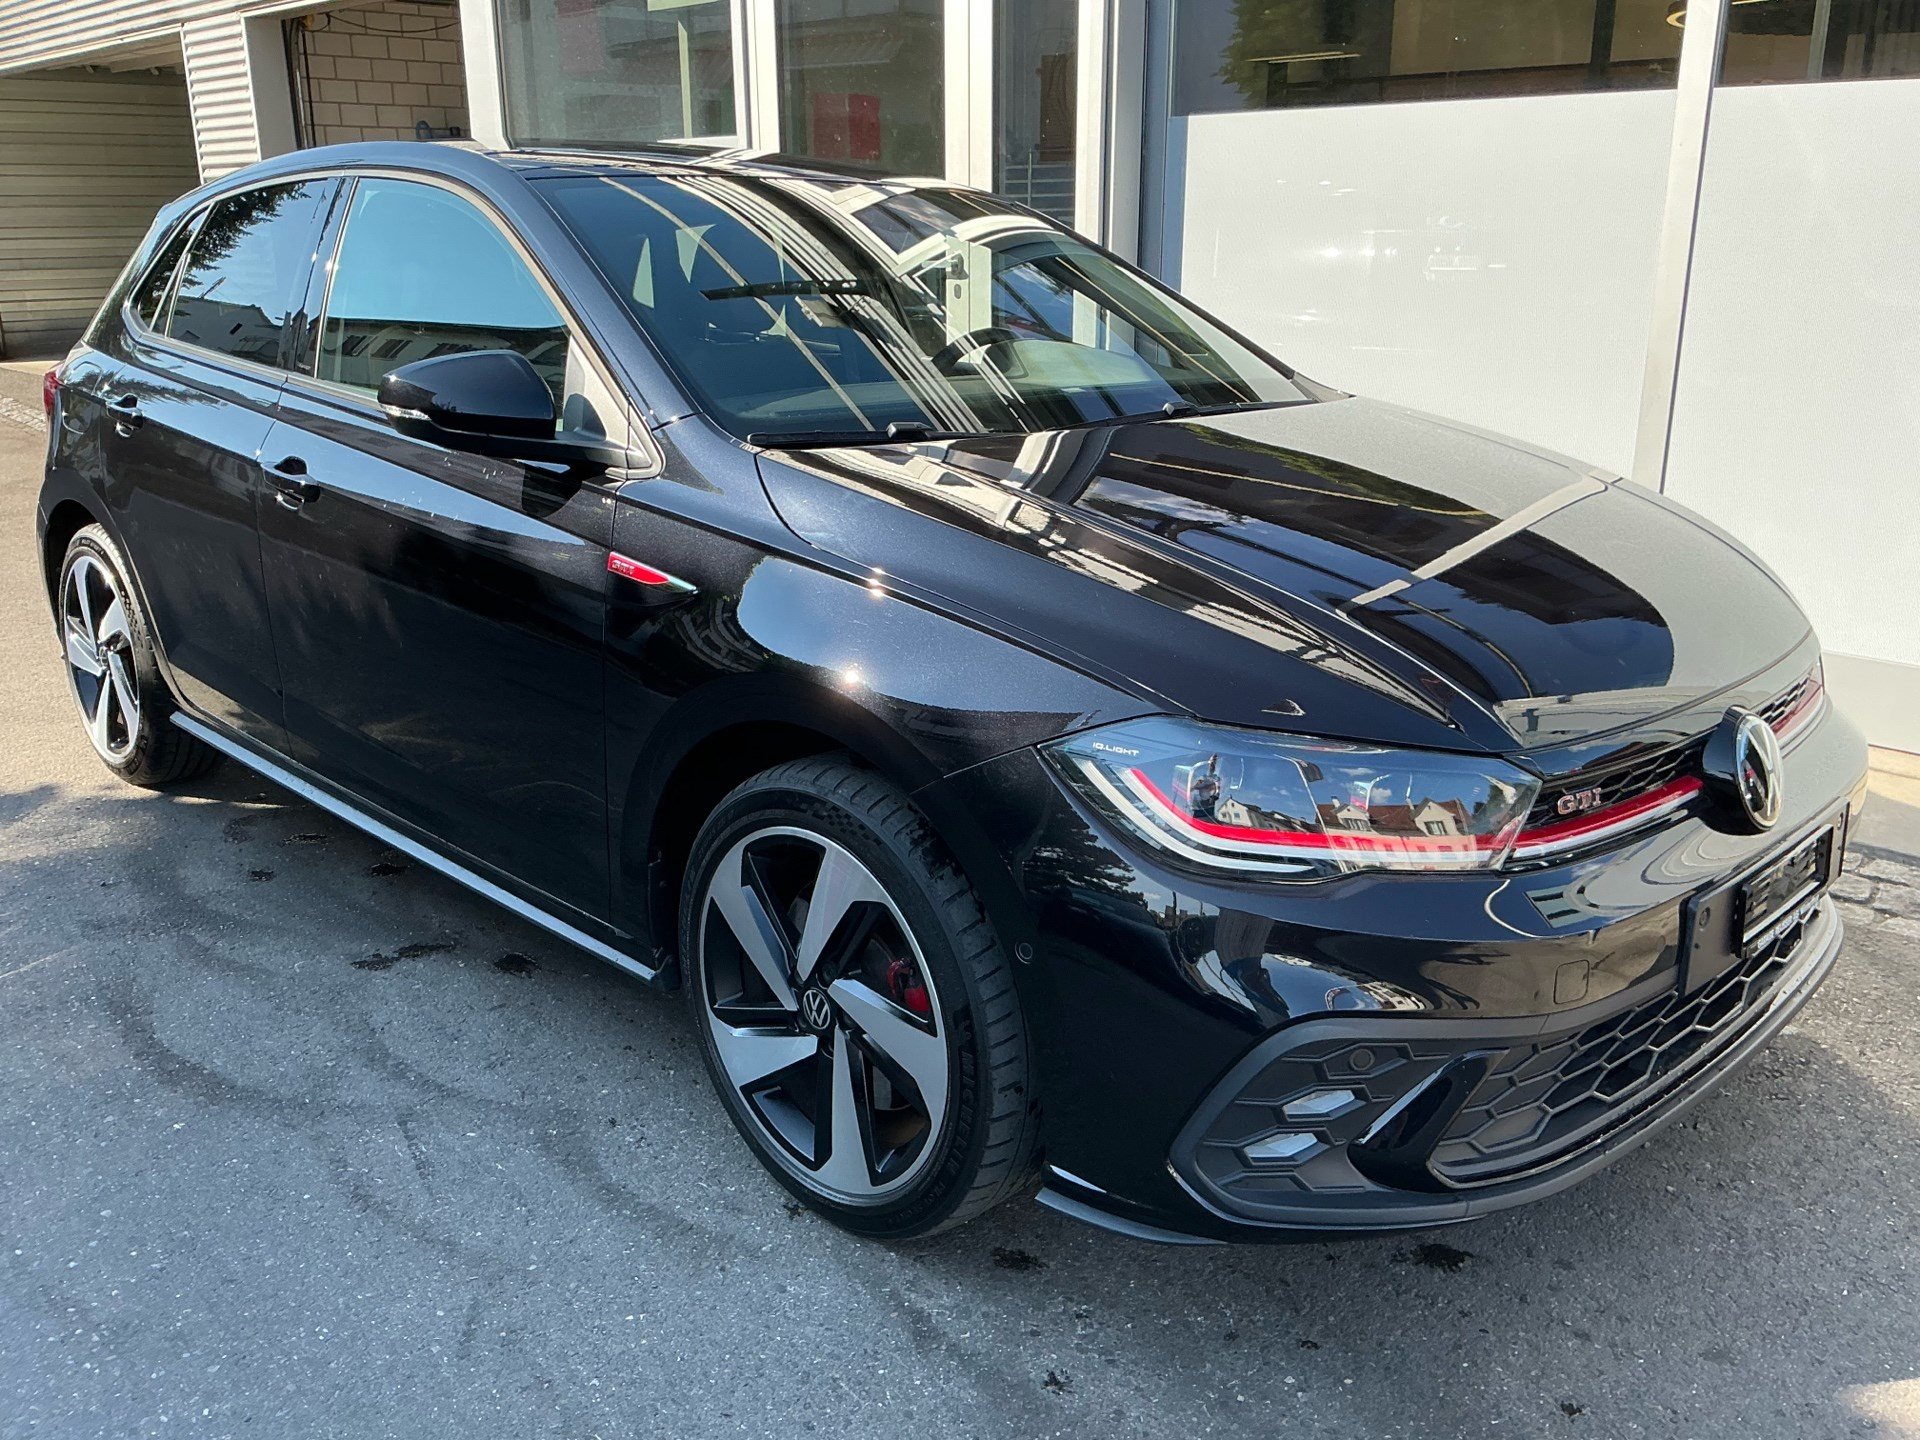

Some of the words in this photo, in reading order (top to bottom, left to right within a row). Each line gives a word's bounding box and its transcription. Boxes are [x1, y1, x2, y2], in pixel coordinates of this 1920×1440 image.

[1092, 742, 1139, 756] IQ.LIGHT
[1557, 787, 1602, 815] GTI
[947, 1050, 977, 1173] MICHELIN
